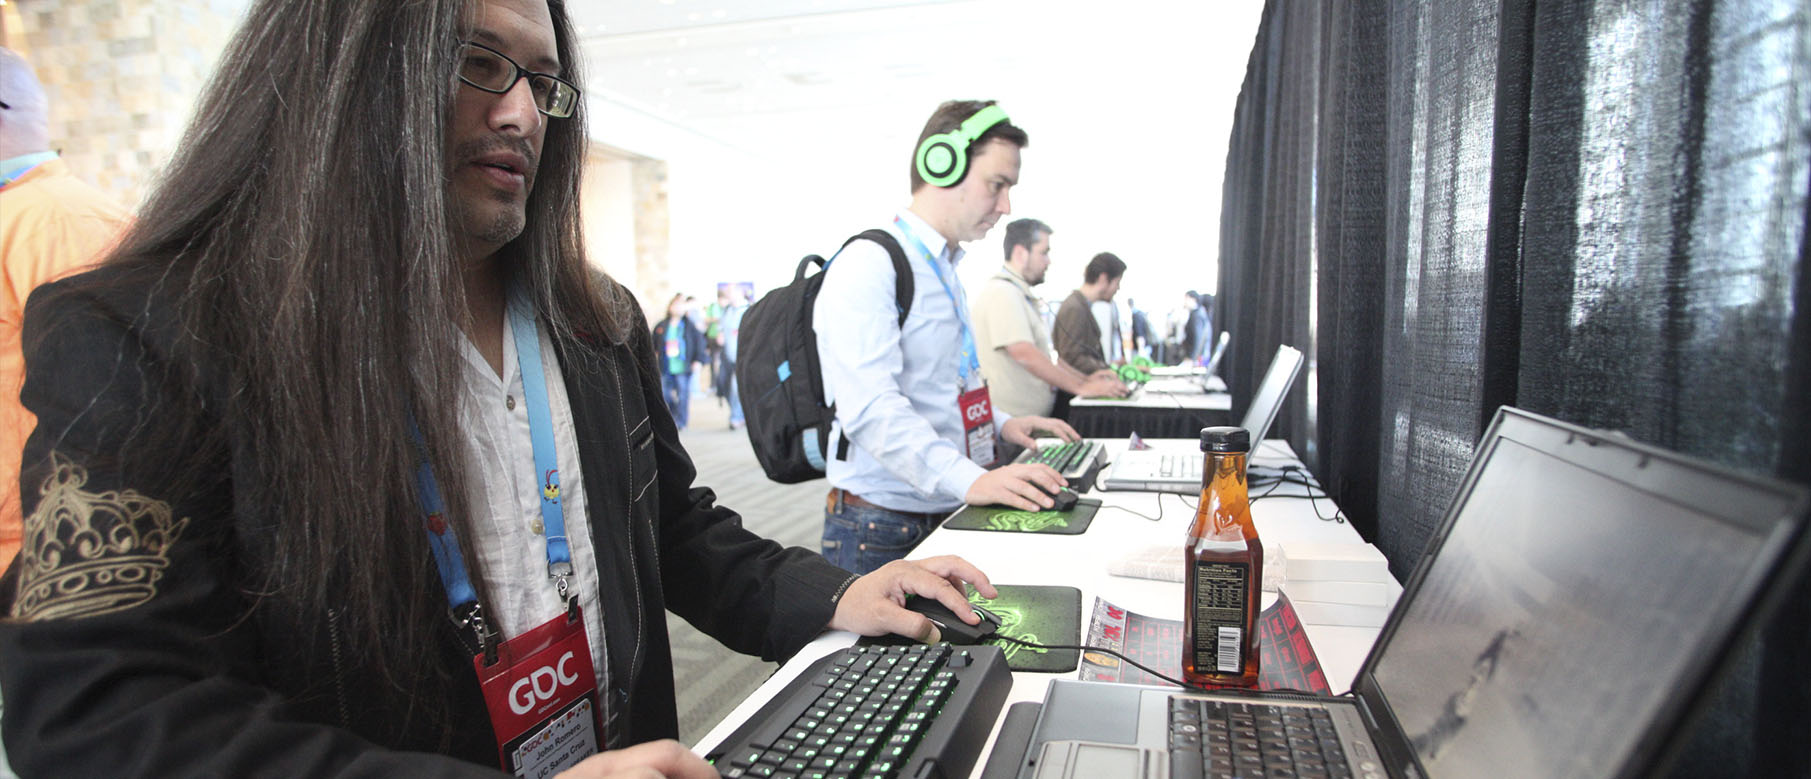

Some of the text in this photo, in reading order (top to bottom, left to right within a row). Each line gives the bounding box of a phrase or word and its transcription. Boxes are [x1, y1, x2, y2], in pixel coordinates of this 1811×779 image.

[967, 400, 989, 421] GDC
[508, 651, 579, 715] GDC
[536, 723, 582, 761] John Romero
[537, 739, 586, 779] UC Santa Cruz
